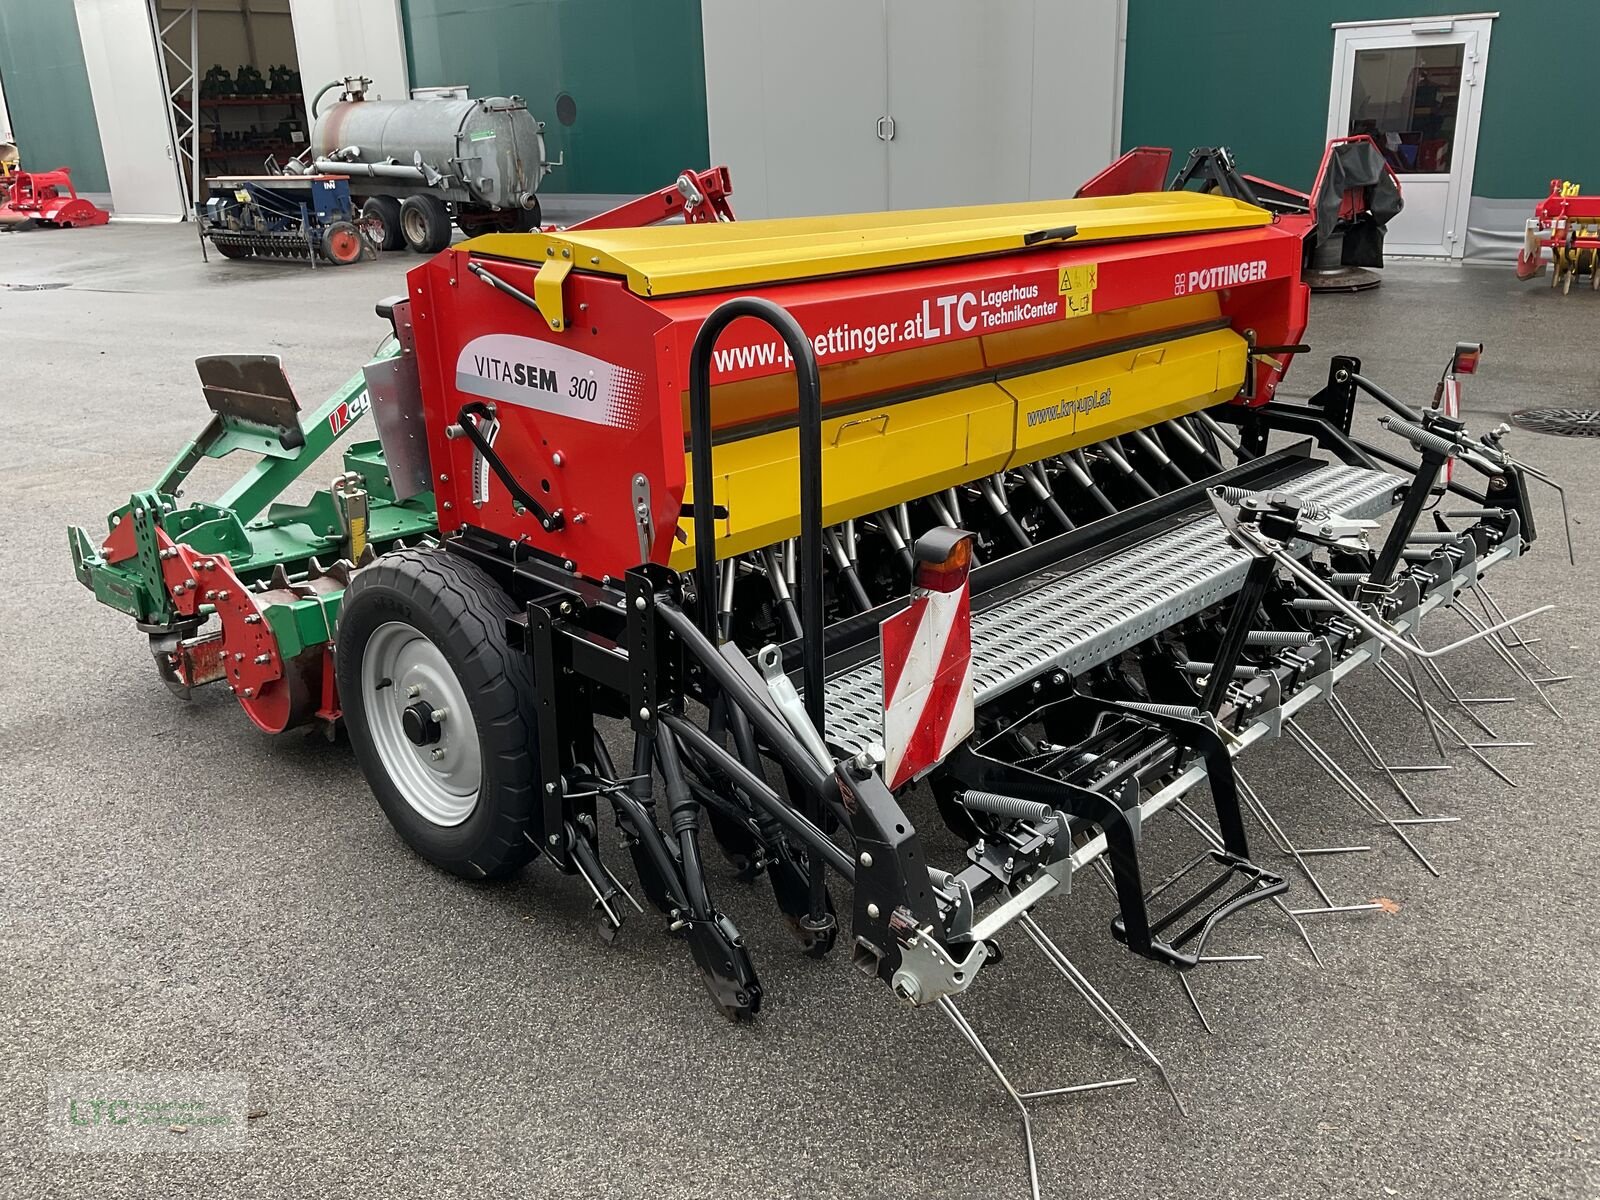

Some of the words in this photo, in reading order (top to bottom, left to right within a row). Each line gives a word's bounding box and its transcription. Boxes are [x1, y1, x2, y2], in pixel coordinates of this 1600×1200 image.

[922, 292, 978, 339] LTC
[981, 284, 1039, 308] Lagerhaus
[981, 302, 1059, 328] TechnikCenter
[713, 313, 923, 373] www.pettinger.at
[474, 355, 559, 393] VITASEM
[568, 376, 598, 401] 300
